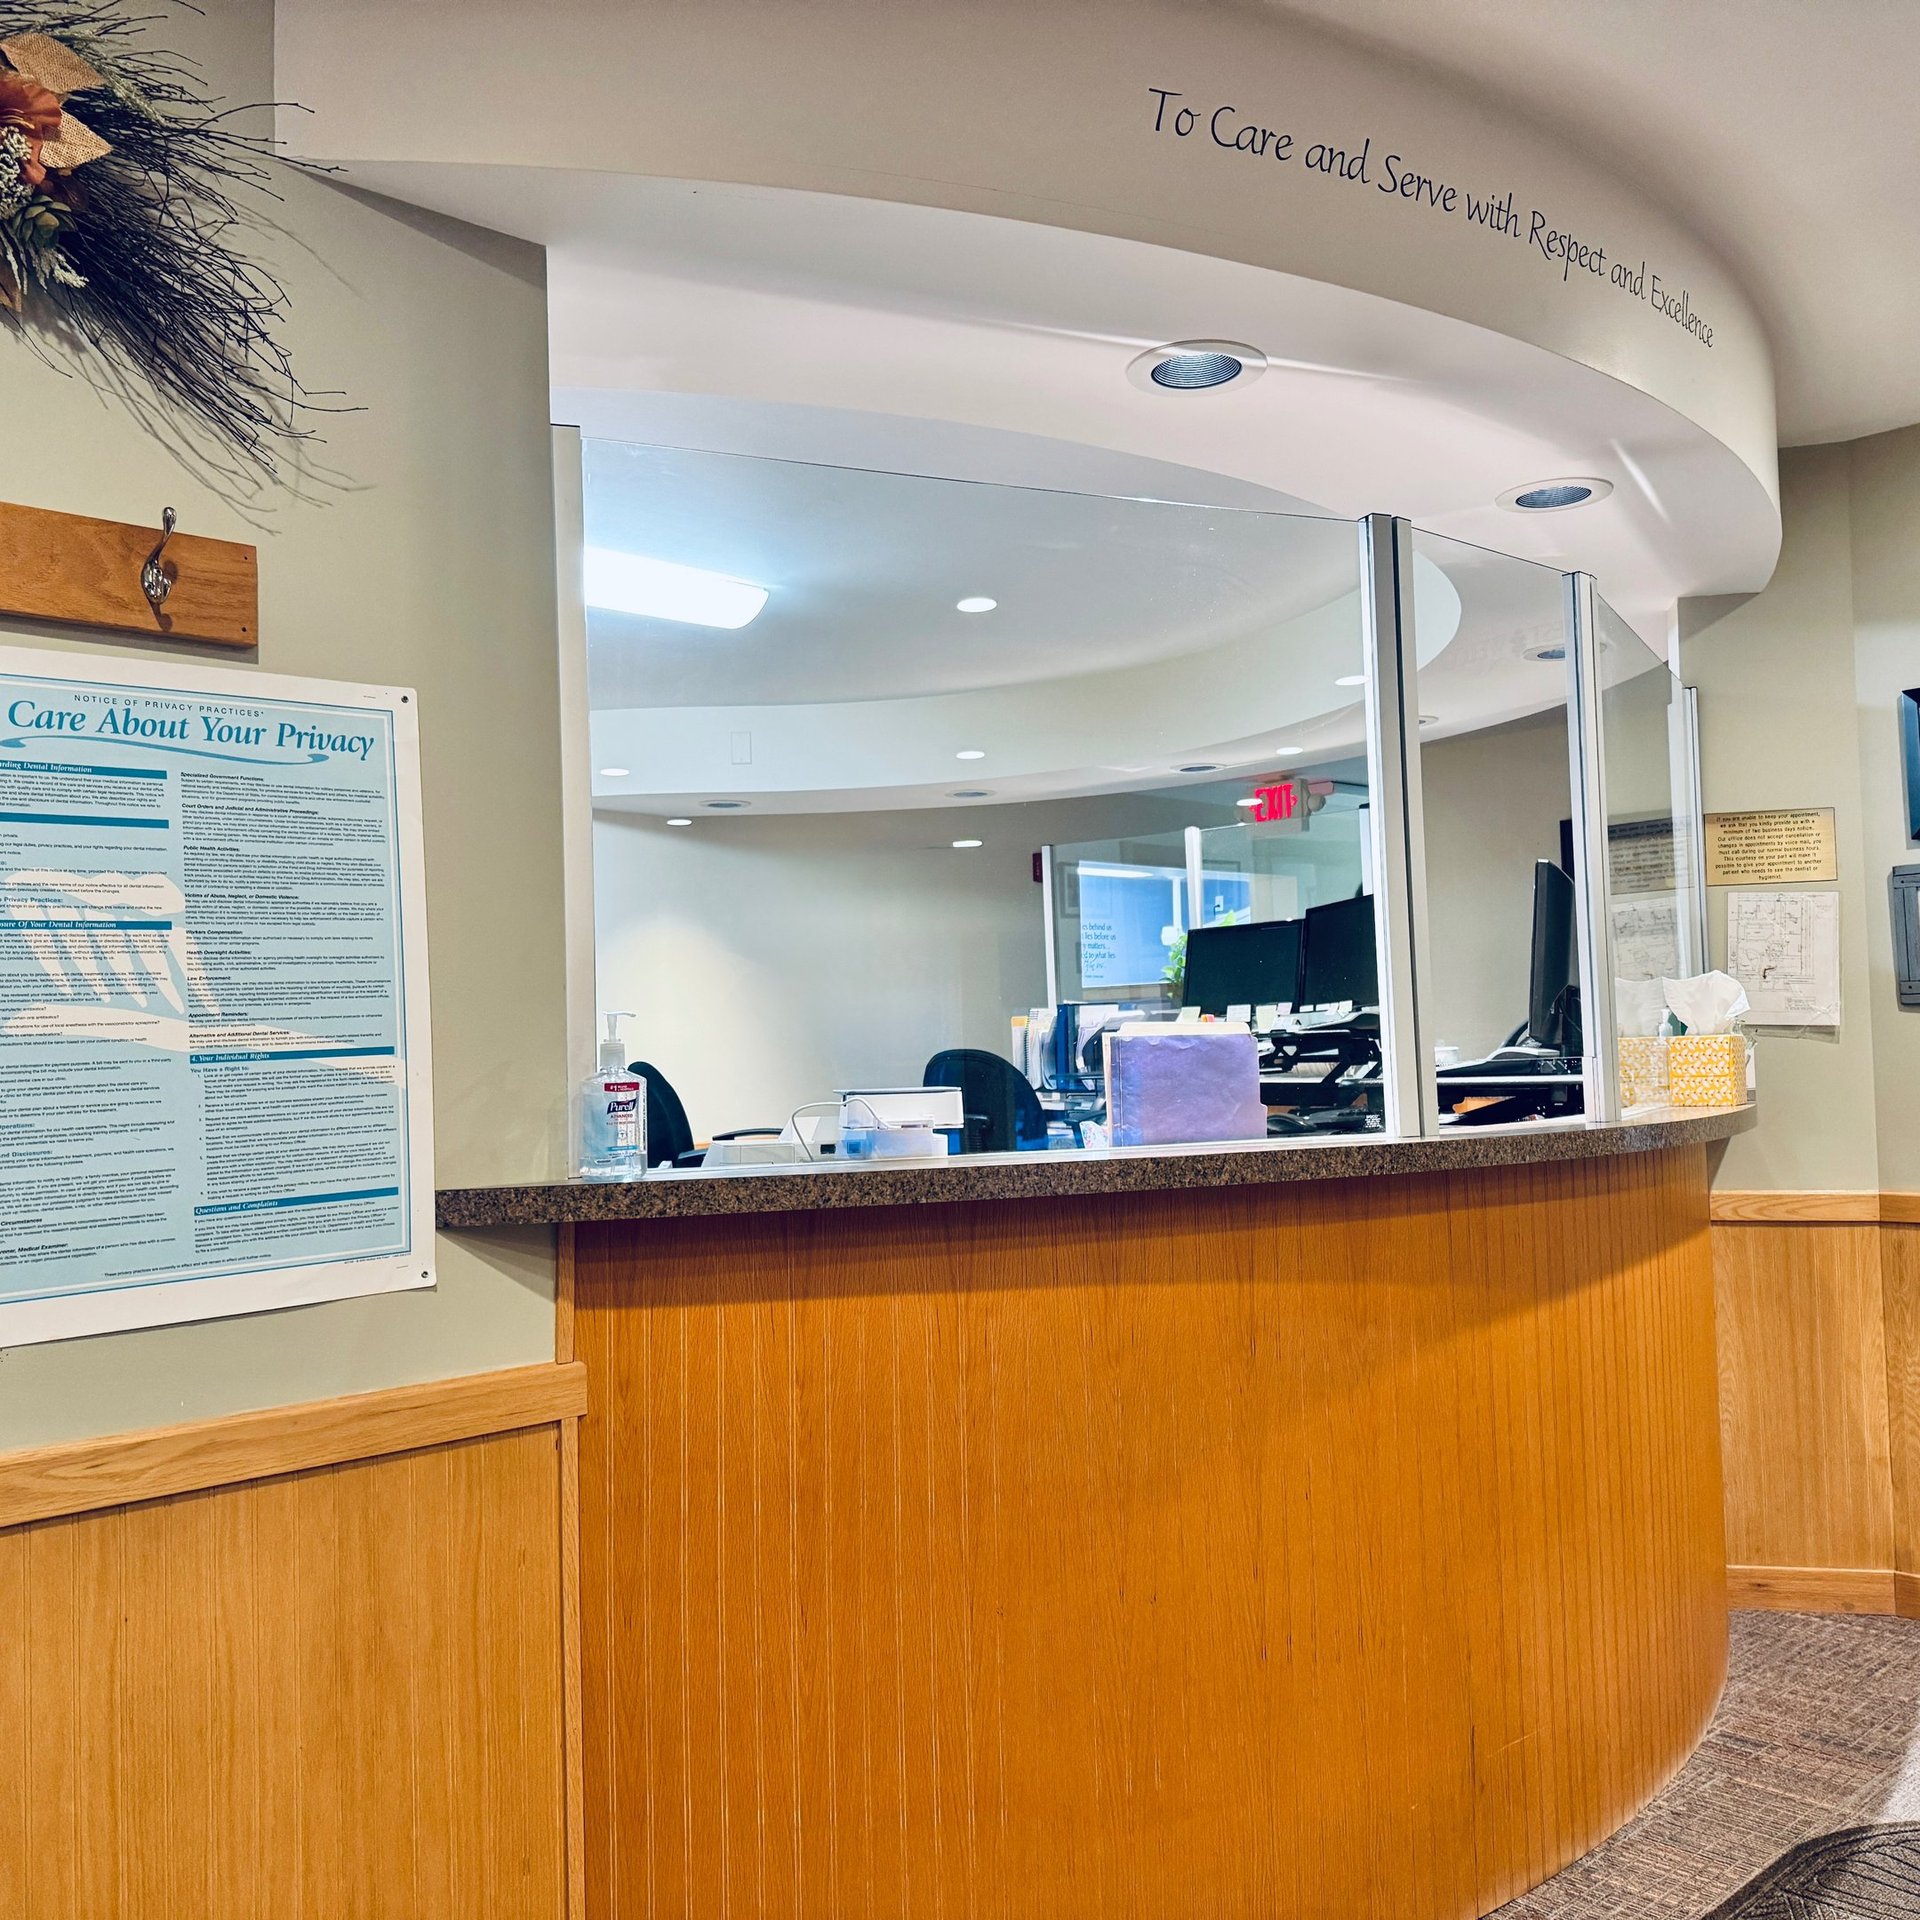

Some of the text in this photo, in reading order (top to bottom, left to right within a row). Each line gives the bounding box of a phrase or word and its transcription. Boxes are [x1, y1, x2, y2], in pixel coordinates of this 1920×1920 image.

[1148, 87, 1714, 348] To Care and Serve with Respect and Excellence
[74, 694, 117, 705] NOTICE
[145, 700, 193, 711] PRIVACY
[8, 700, 374, 761] Care About Your Privacy
[24, 762, 48, 770] Dental
[50, 764, 92, 773] Information
[1255, 784, 1293, 823] EXIT
[18, 921, 28, 929] Of
[48, 920, 73, 928] Dental
[75, 921, 116, 929] Information
[250, 1053, 270, 1061] Rights
[610, 1102, 634, 1112] Purell
[242, 1201, 278, 1209] Complaints
